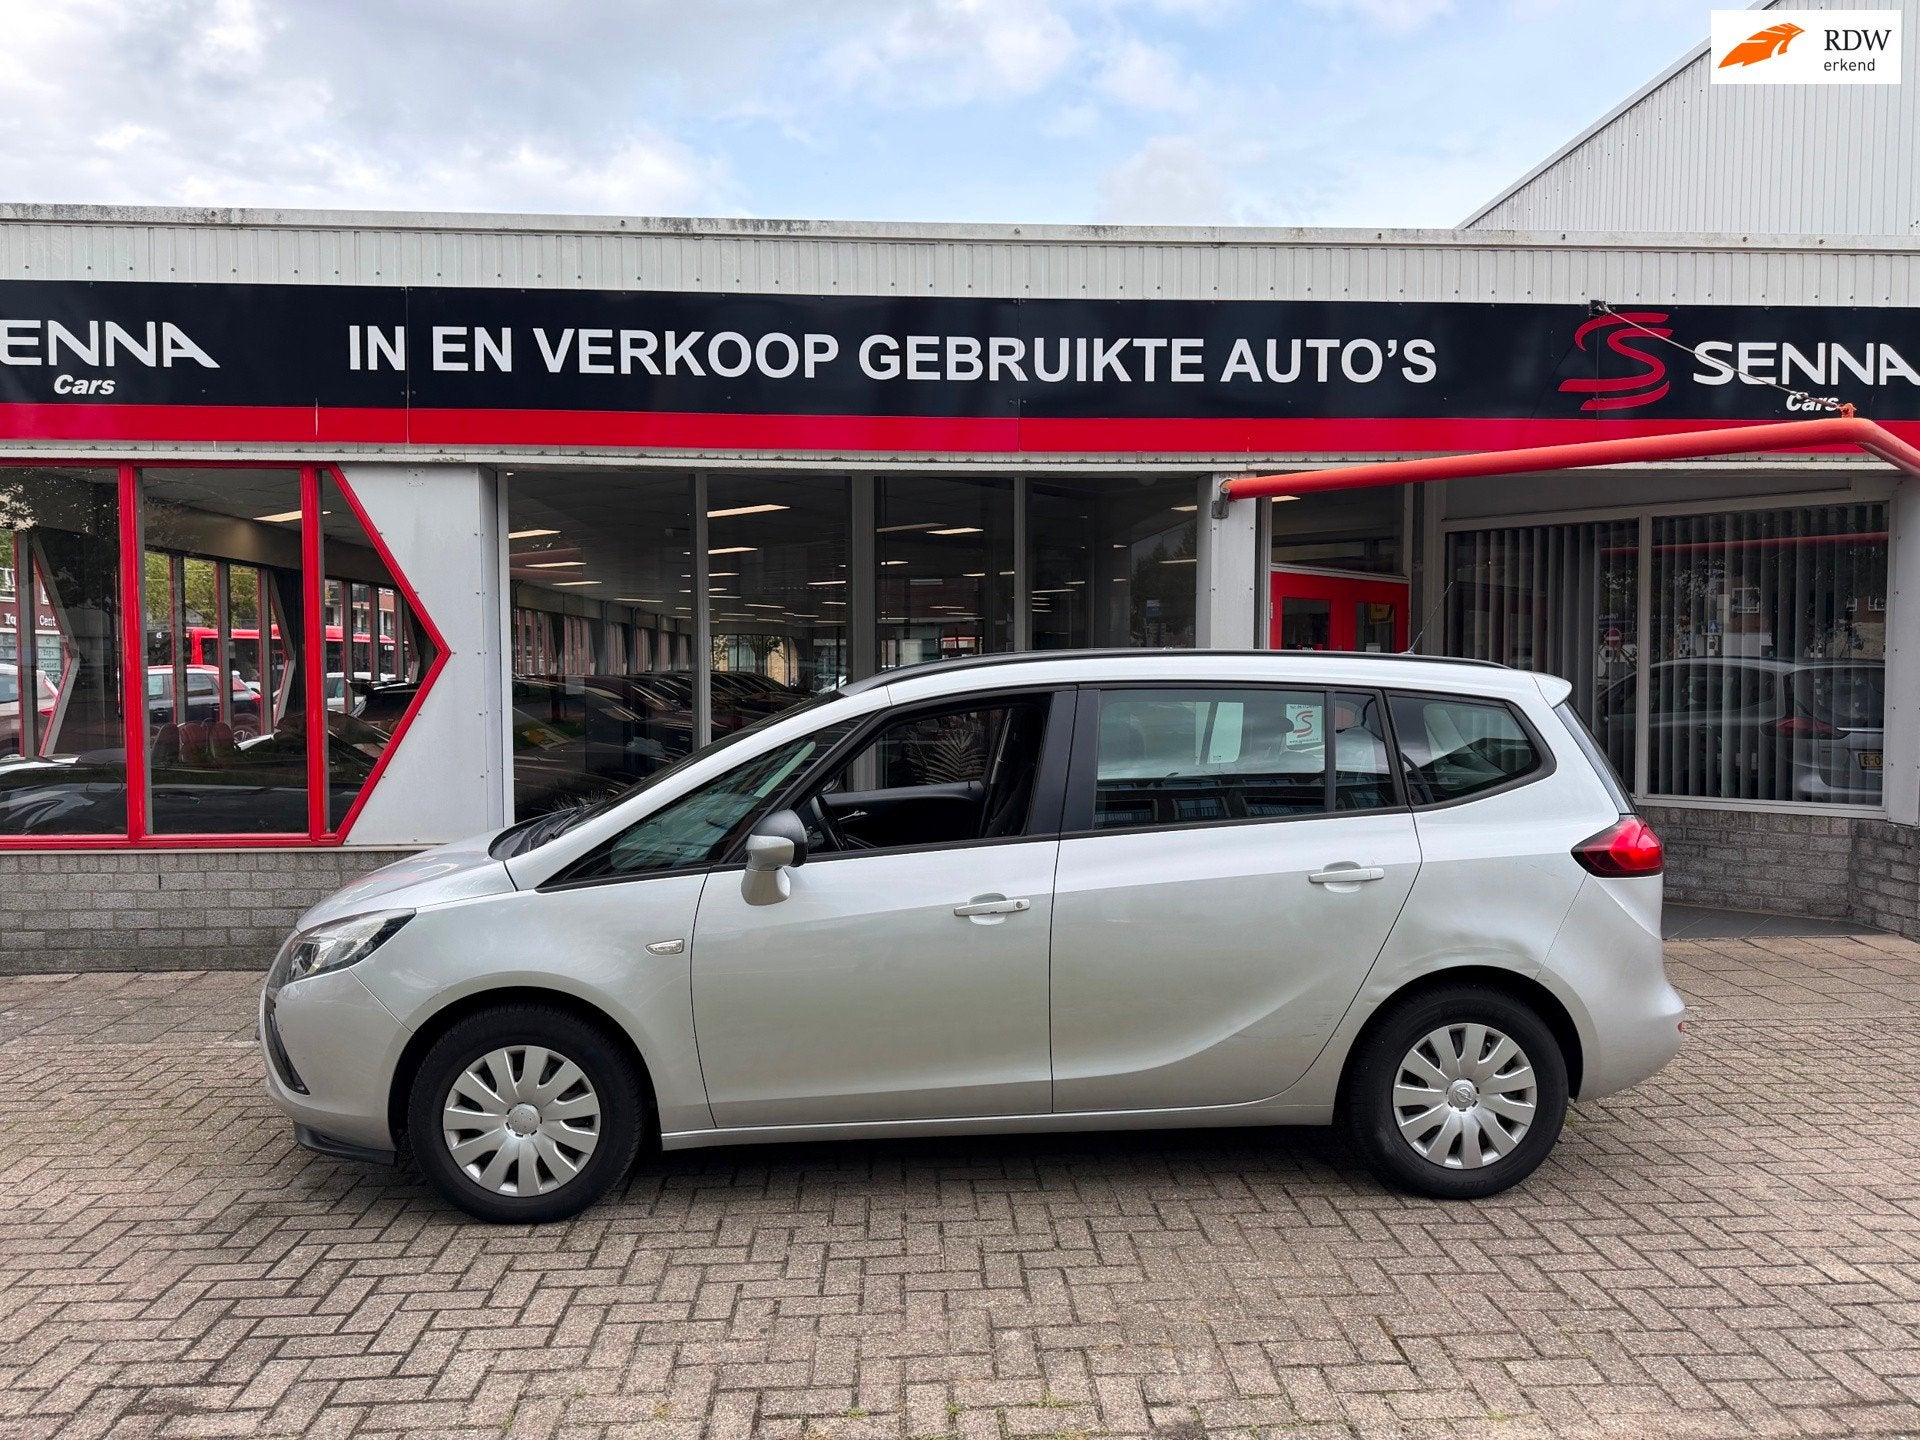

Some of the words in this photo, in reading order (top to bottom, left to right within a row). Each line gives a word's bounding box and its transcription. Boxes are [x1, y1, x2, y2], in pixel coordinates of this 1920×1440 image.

[0, 319, 220, 368] ENNA
[350, 326, 405, 370] IN
[433, 327, 511, 371] EN
[533, 328, 838, 378] VERKOOP
[859, 335, 1204, 382] GEBRUIKTE
[1220, 339, 1436, 383] AUTO'S
[1692, 341, 1920, 386] SENNA
[54, 374, 116, 395] Cars
[1786, 392, 1839, 411] Cars
[40, 614, 56, 627] Cent
